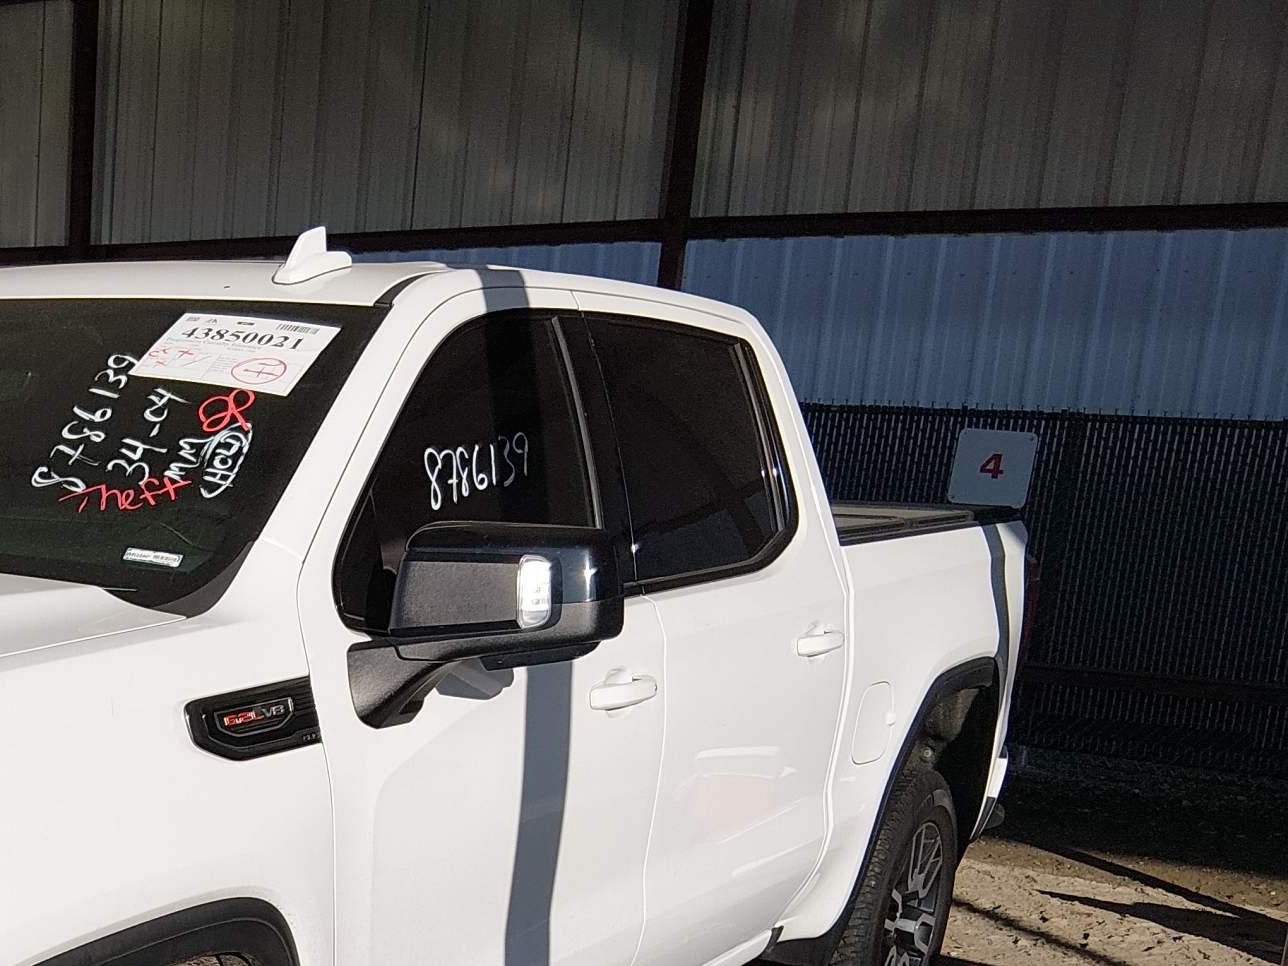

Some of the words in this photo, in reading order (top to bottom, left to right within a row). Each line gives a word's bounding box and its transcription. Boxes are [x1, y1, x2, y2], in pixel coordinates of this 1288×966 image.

[181, 326, 305, 350] 43850021
[31, 353, 139, 492] 8786139
[423, 431, 529, 511] 8786139
[979, 453, 1004, 480] 4
[58, 476, 192, 513] Theft
